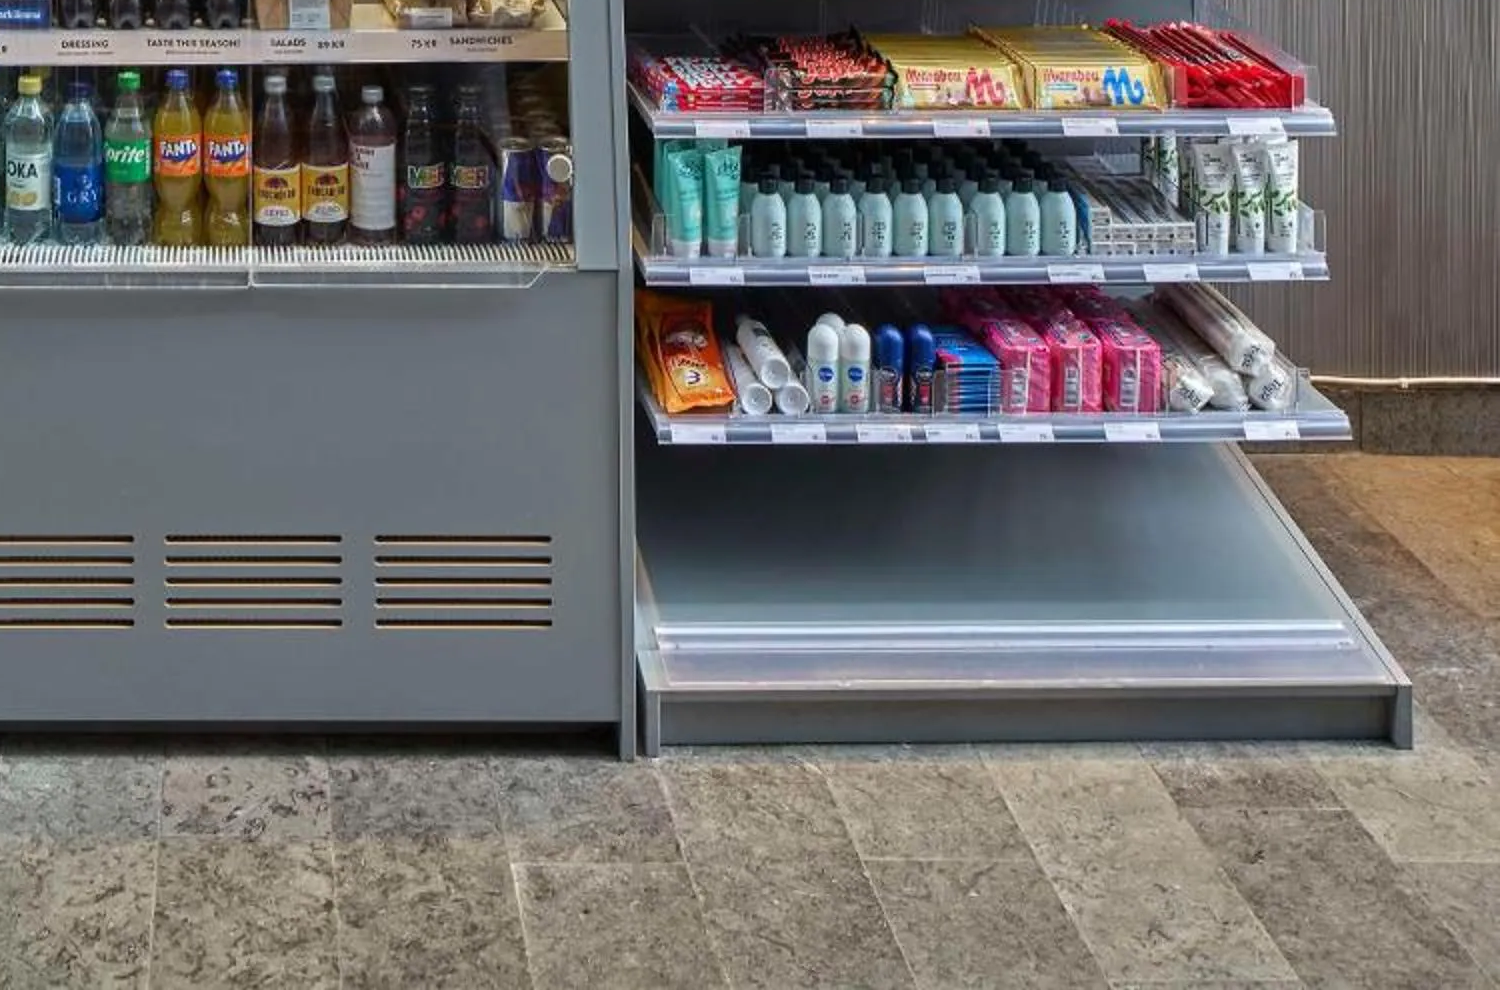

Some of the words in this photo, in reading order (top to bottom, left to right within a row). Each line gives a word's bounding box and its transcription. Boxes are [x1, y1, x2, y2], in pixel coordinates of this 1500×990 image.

[61, 39, 109, 49] DRESSING
[105, 144, 146, 164] prite
[7, 160, 39, 179] OKA
